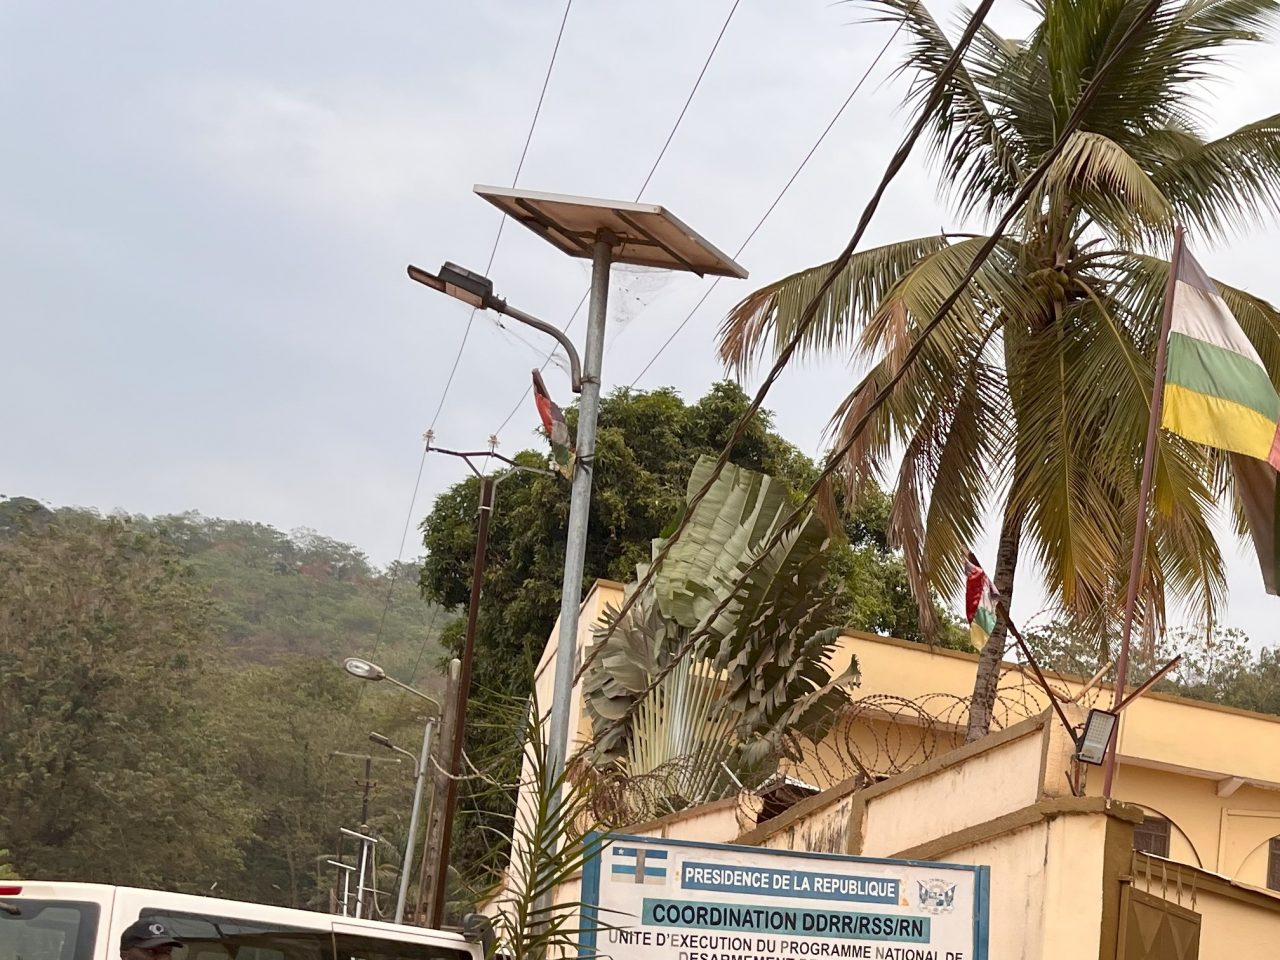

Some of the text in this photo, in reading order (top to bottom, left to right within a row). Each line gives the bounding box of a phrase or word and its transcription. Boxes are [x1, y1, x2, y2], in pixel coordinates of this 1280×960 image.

[685, 867, 896, 898] PRESIDENCE DE LA REPUBLIQUE
[652, 903, 923, 938] COORDINATION DDRR/RSS/RN
[608, 928, 652, 946] UNITE
[656, 932, 751, 951] D'EXECUTION
[756, 938, 776, 953] DU
[780, 941, 872, 959] PROGRAMME
